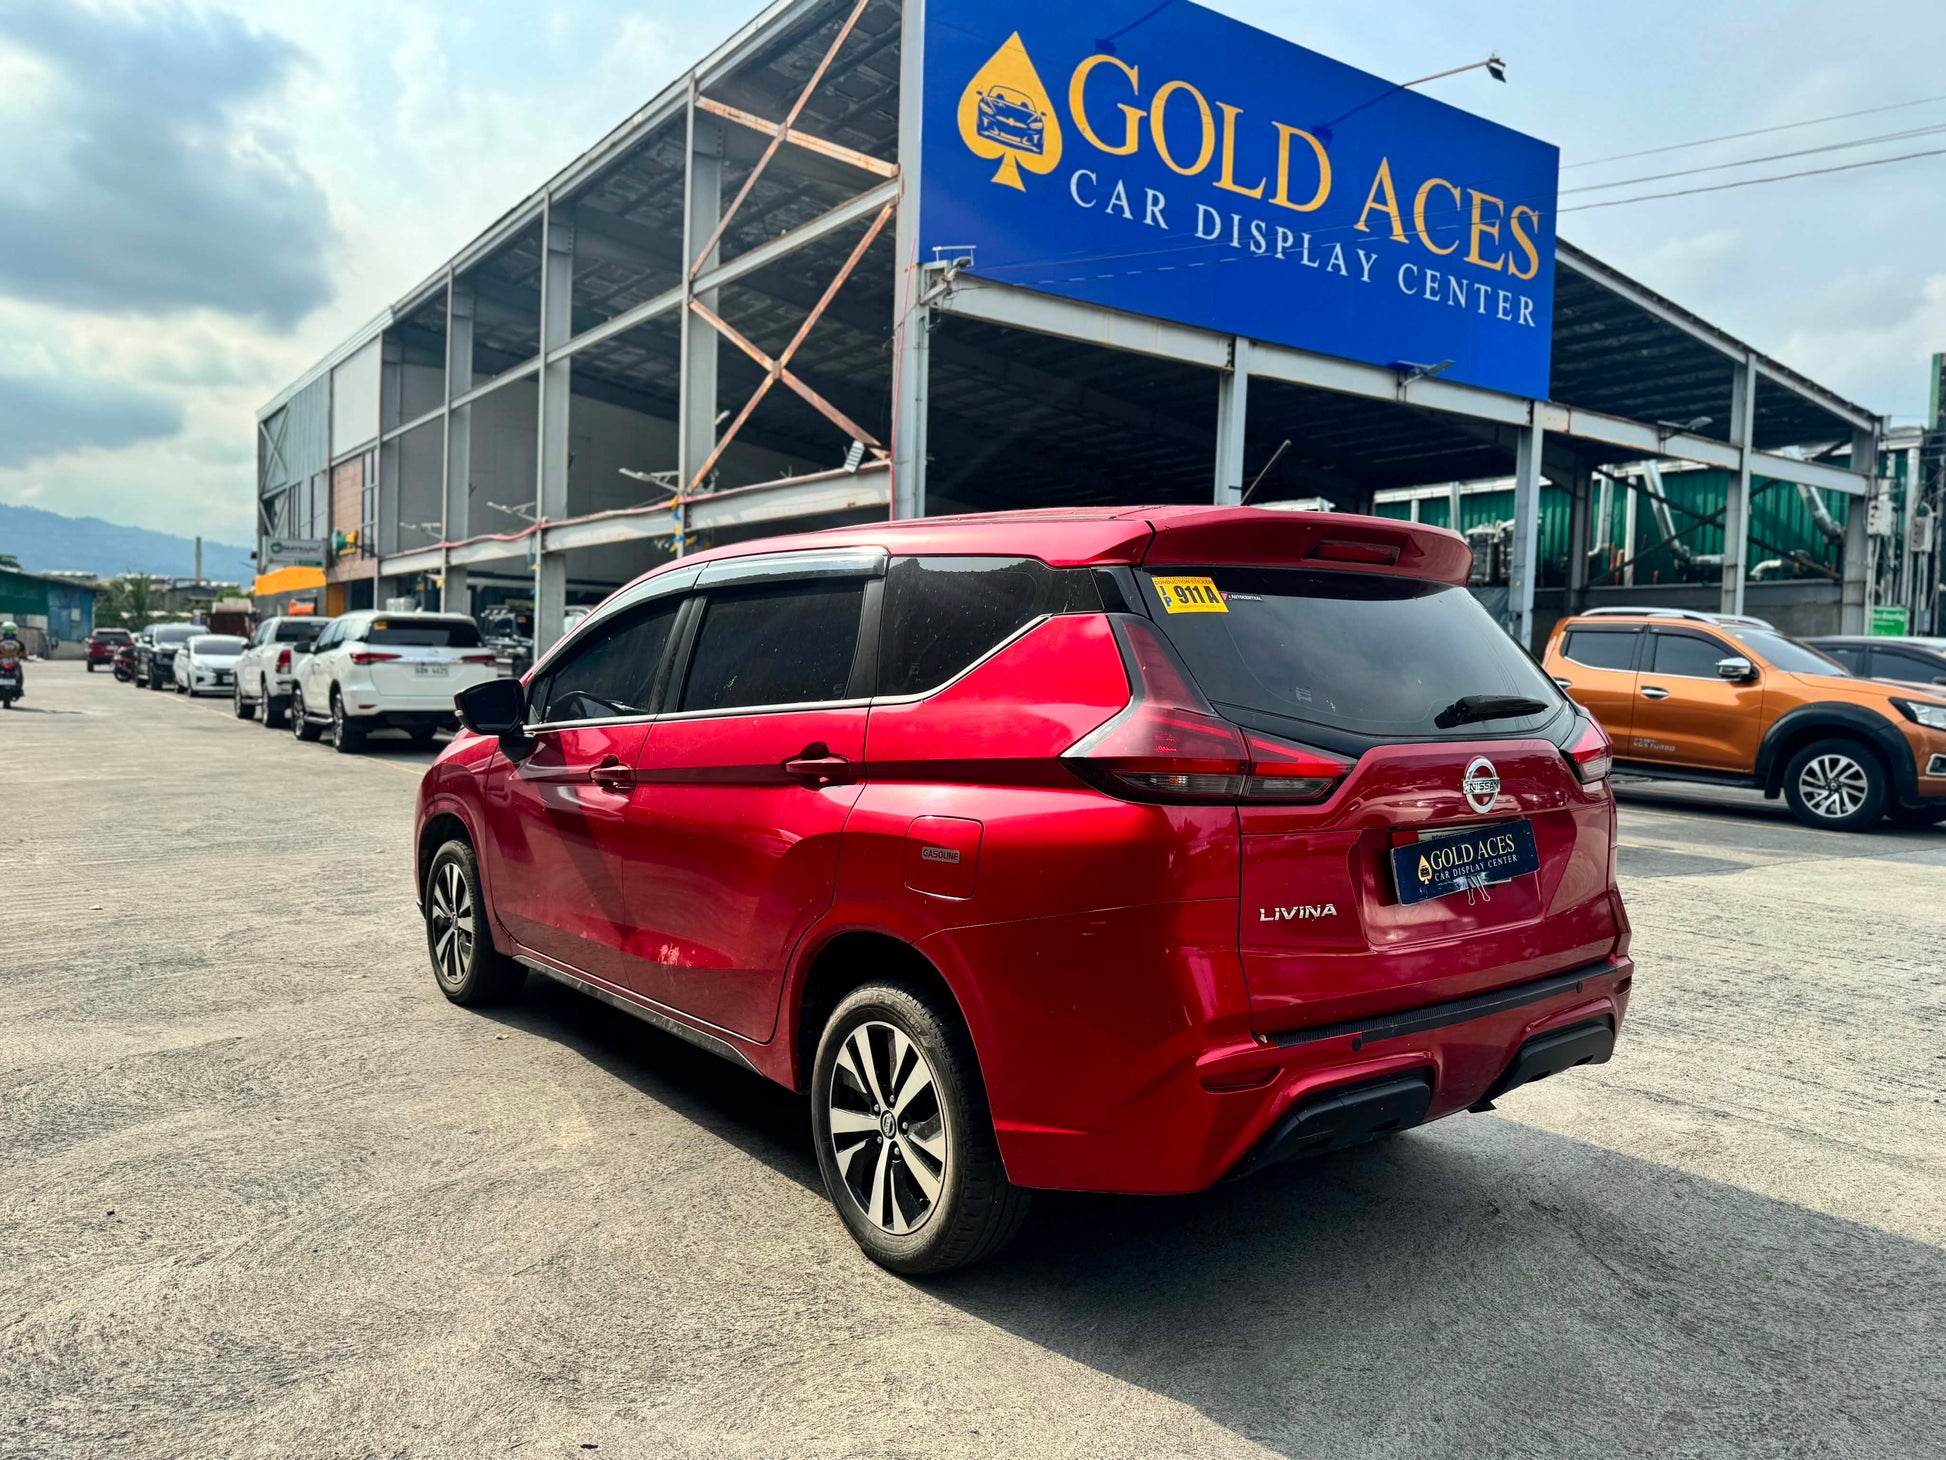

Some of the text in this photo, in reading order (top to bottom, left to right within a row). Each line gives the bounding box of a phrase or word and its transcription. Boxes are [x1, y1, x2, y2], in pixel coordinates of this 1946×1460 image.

[1068, 54, 1539, 280] GOLD ACES
[1069, 169, 1536, 328] CAR DISPLAY CENTER
[1468, 781, 1499, 791] NISSAN
[923, 849, 959, 861] GASOLINE
[1430, 834, 1515, 870] GOLD ACES
[1434, 854, 1518, 881] CAR DISPLAY CENTER
[1260, 904, 1338, 921] LIVINA
